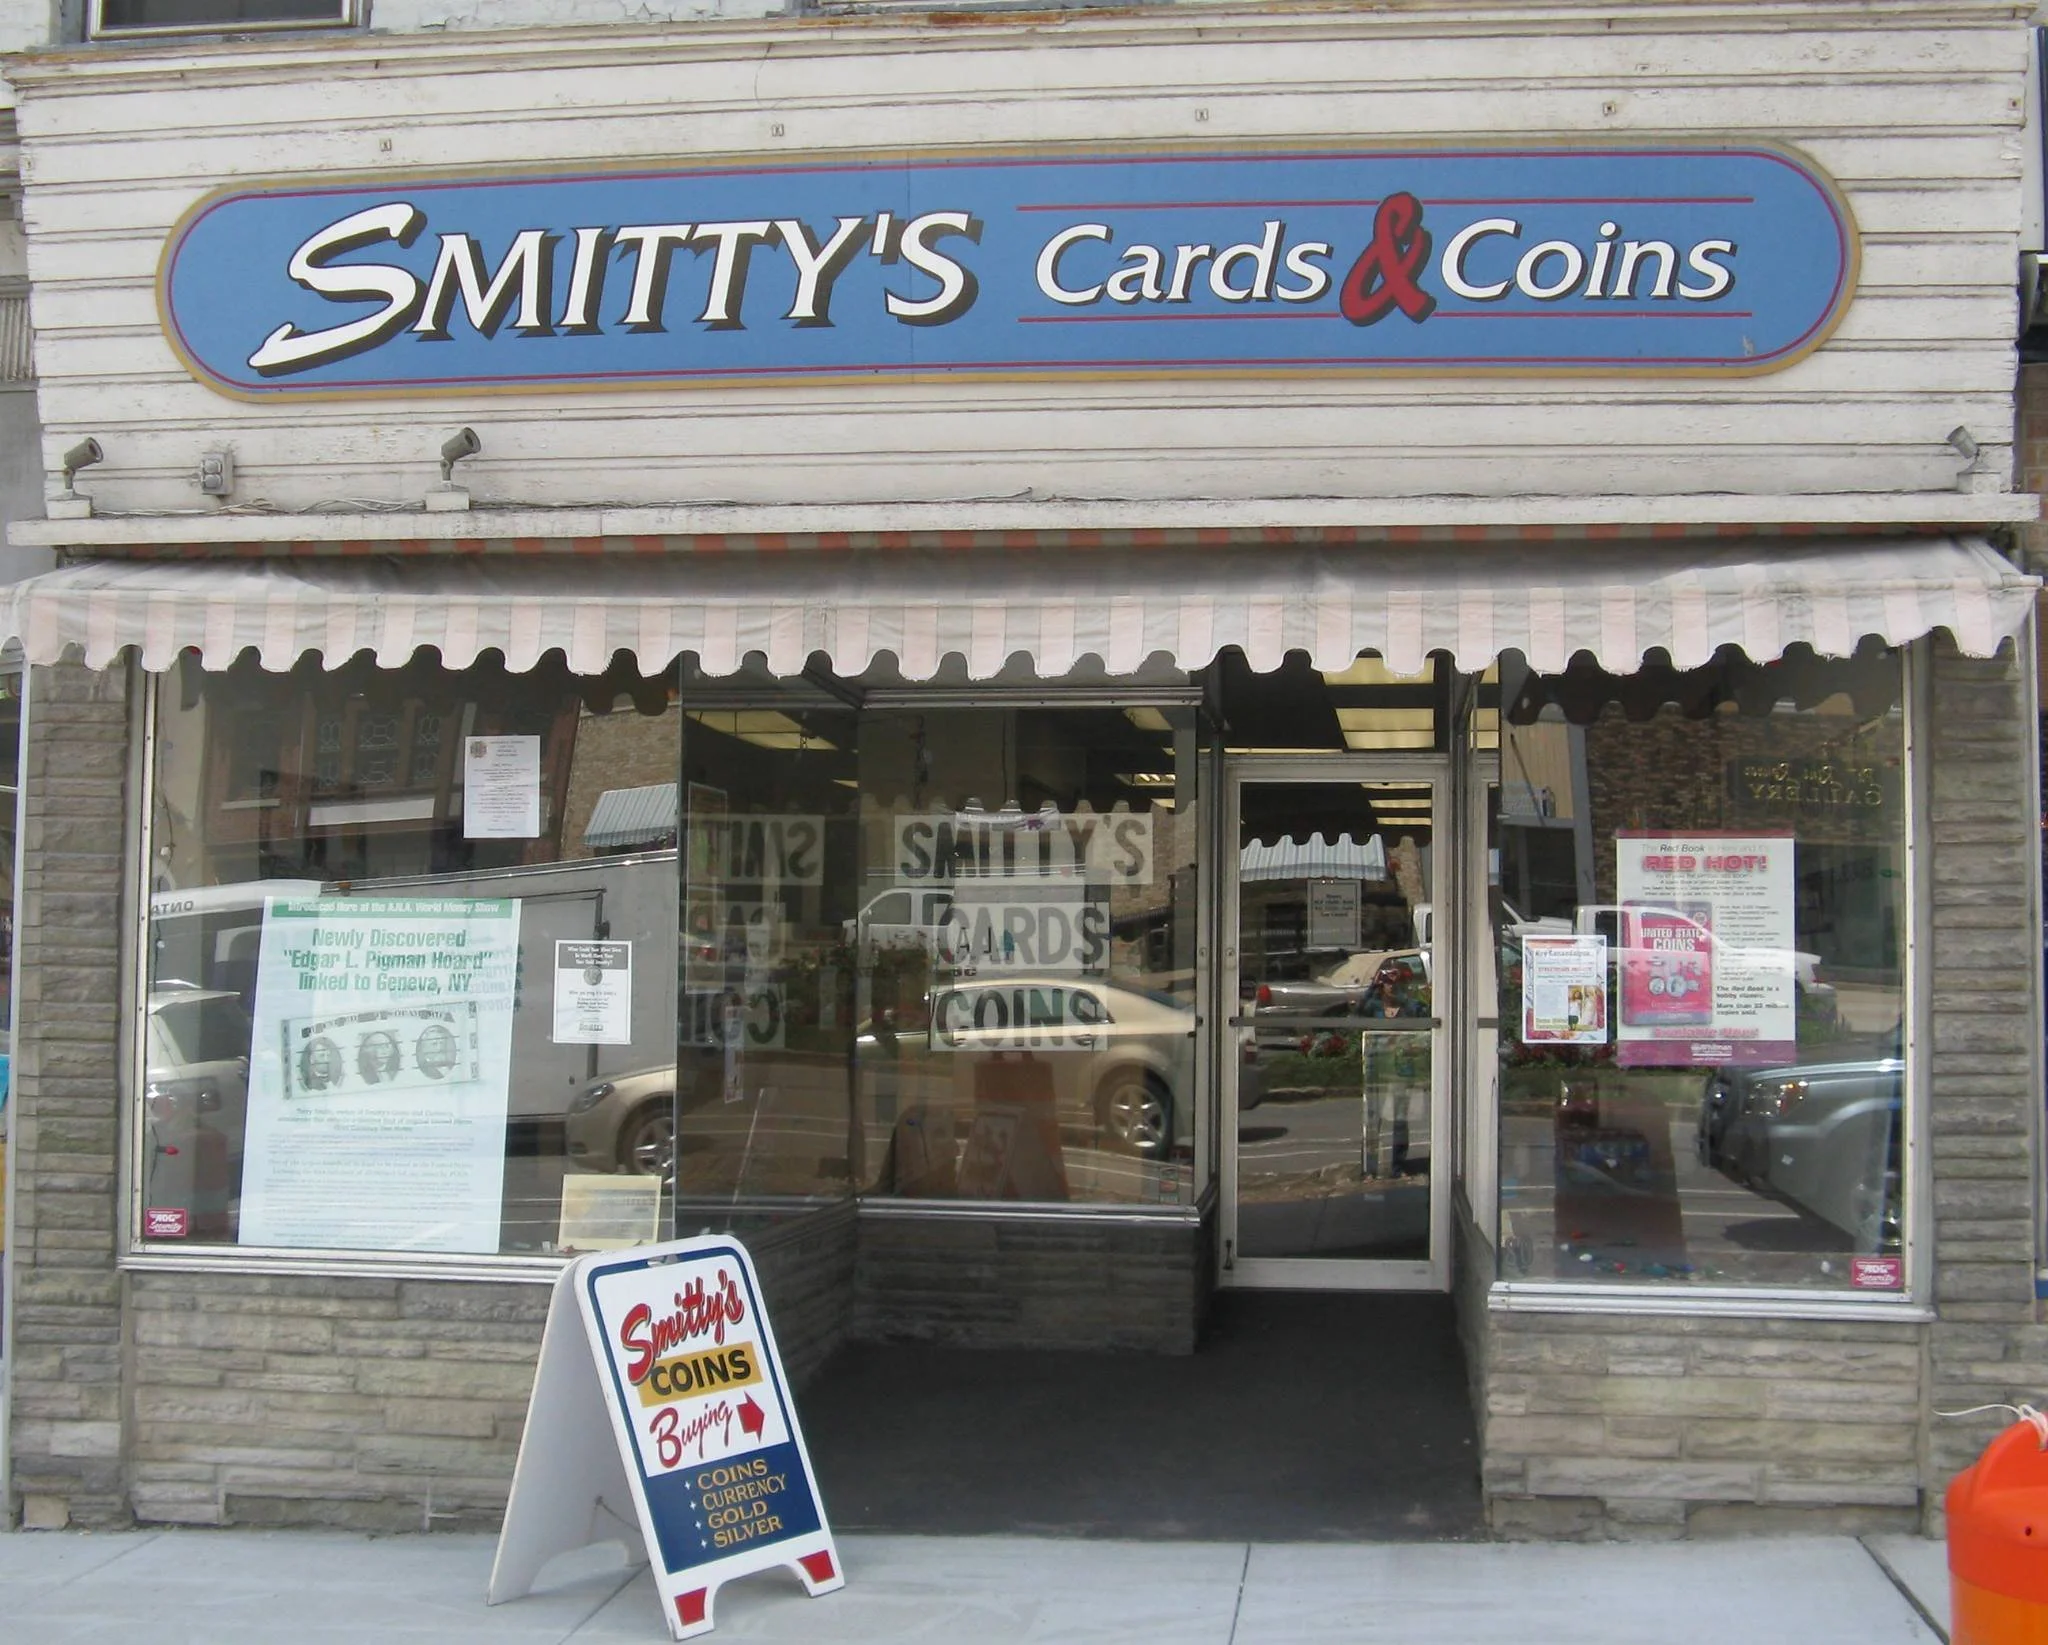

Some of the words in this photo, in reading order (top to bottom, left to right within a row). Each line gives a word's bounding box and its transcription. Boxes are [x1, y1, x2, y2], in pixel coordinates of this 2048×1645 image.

[248, 200, 981, 375] SMITTY'S
[1036, 219, 1333, 307] Cards
[1340, 191, 1436, 328] &
[1440, 217, 1737, 303] Coins
[900, 815, 1147, 878] SMITTY'S
[1660, 843, 1679, 852] Red
[1681, 844, 1705, 853] Book
[1643, 855, 1697, 872] RED
[1704, 855, 1768, 872] HOT!
[416, 902, 442, 912] World
[444, 903, 473, 914] Money
[475, 903, 499, 912] Show
[312, 928, 364, 948] Newly
[370, 929, 466, 947] Discovered
[937, 906, 1105, 965] CARDS
[1641, 927, 1673, 938] UNITED
[1653, 938, 1695, 951] COINS
[284, 950, 340, 971] "Edgar
[345, 951, 359, 969] L.
[365, 951, 425, 971] Pigman
[299, 971, 347, 991] linked
[355, 973, 370, 990] to
[376, 973, 441, 994] Geneva,
[448, 973, 471, 992] NY
[935, 989, 1107, 1047] COINS
[620, 1268, 744, 1385] Smitty's
[650, 1350, 751, 1396] COINS
[649, 1400, 733, 1469] Buying
[697, 1459, 768, 1491] COINS
[702, 1474, 786, 1511] CURRENCY
[708, 1500, 768, 1529] GOLD
[713, 1516, 783, 1548] SILVER
